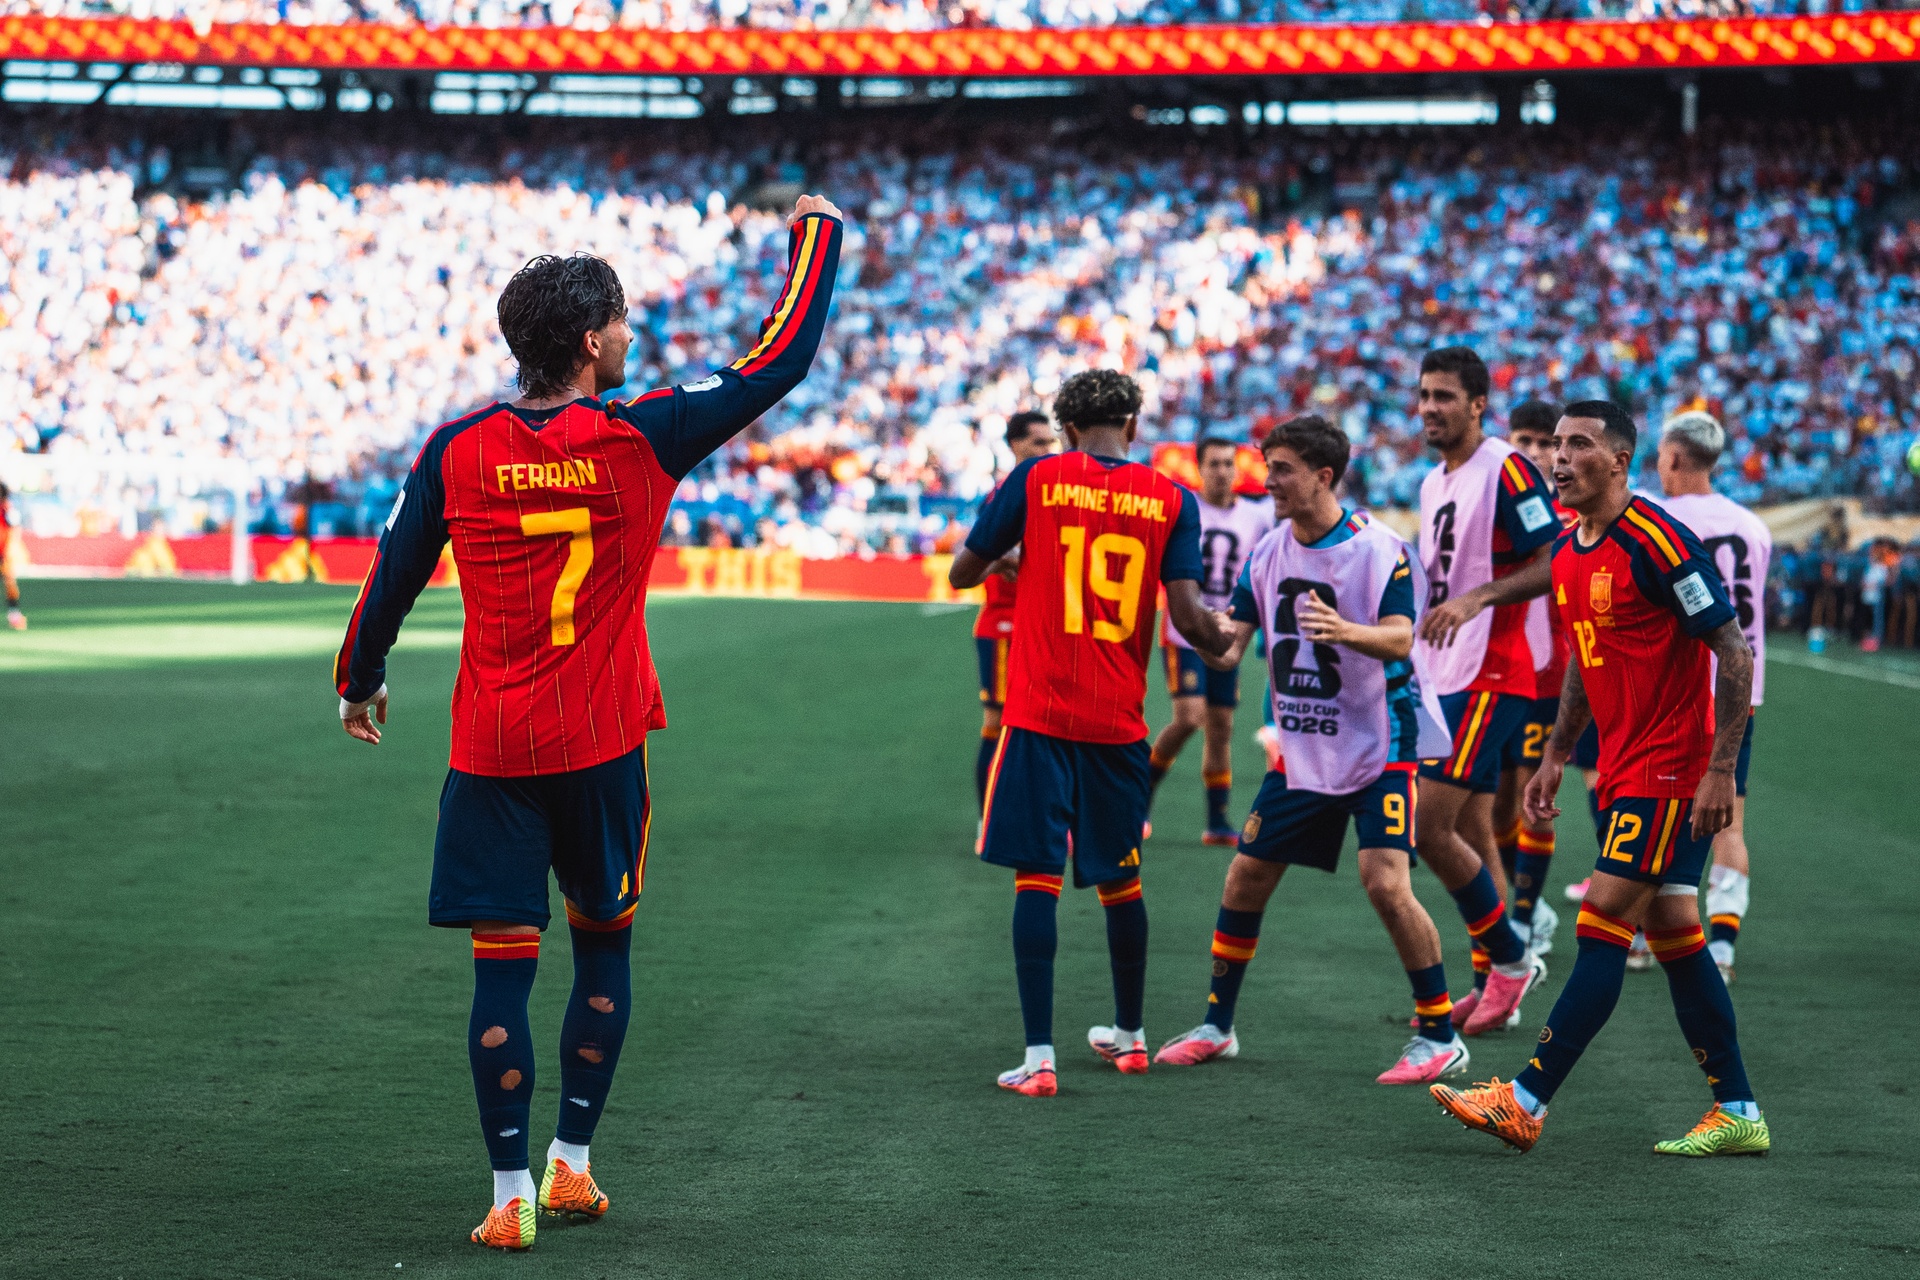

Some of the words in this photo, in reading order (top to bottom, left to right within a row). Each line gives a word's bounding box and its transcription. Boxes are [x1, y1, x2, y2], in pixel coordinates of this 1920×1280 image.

[495, 458, 597, 493] FERRAN
[1042, 483, 1109, 513] LAMINE
[1112, 492, 1167, 522] YAMAL
[520, 507, 594, 646] 7
[677, 546, 802, 597] THIS
[1060, 526, 1146, 643] 19
[1573, 620, 1604, 668] 12
[1289, 673, 1322, 689] FIFA
[1277, 701, 1311, 714] ORLD
[1313, 704, 1341, 717] CUP
[1279, 715, 1339, 737] 026
[1383, 793, 1405, 836] 9
[1602, 811, 1642, 863] 12
